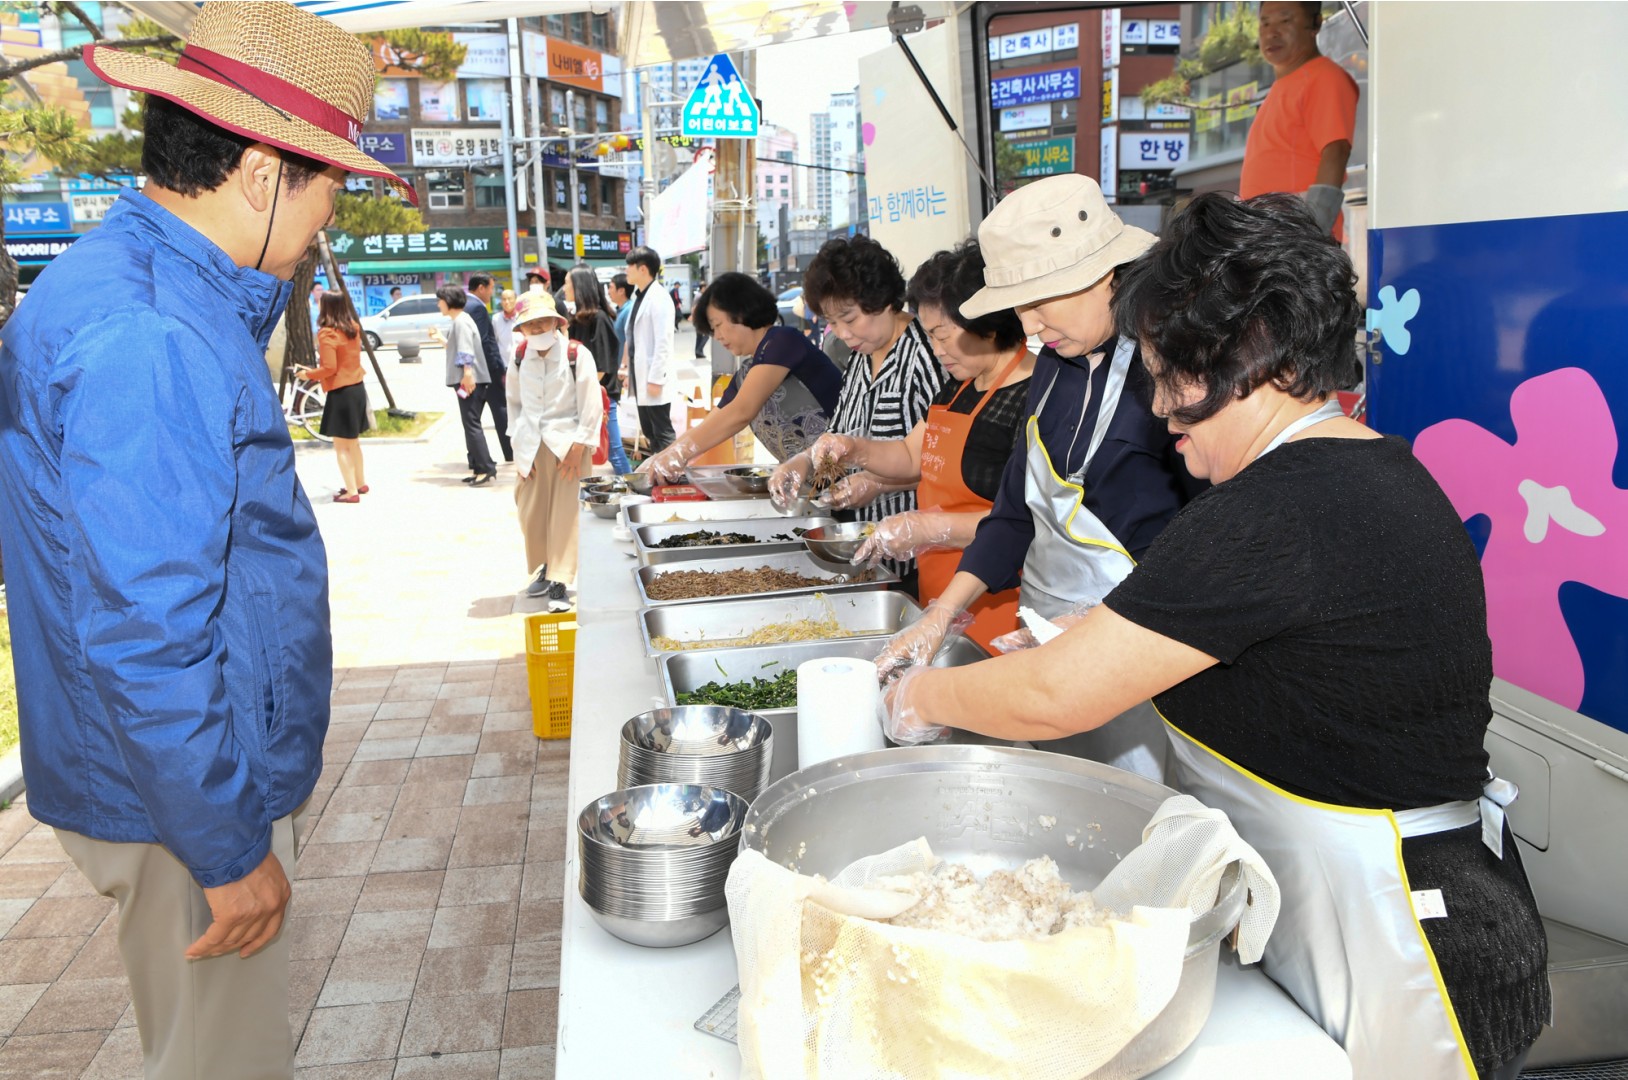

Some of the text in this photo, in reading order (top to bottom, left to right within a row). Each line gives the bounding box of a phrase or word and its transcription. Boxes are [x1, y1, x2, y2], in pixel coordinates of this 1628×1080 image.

[688, 118, 753, 132] 어린이보호
[1140, 139, 1184, 162] 한방
[869, 185, 946, 224] 과 함께하는
[6, 207, 60, 225] 사무소
[6, 243, 49, 256] WOORI
[363, 232, 448, 254] 썬푸르츠
[453, 239, 489, 251] MART
[562, 233, 601, 250] 썬르츠
